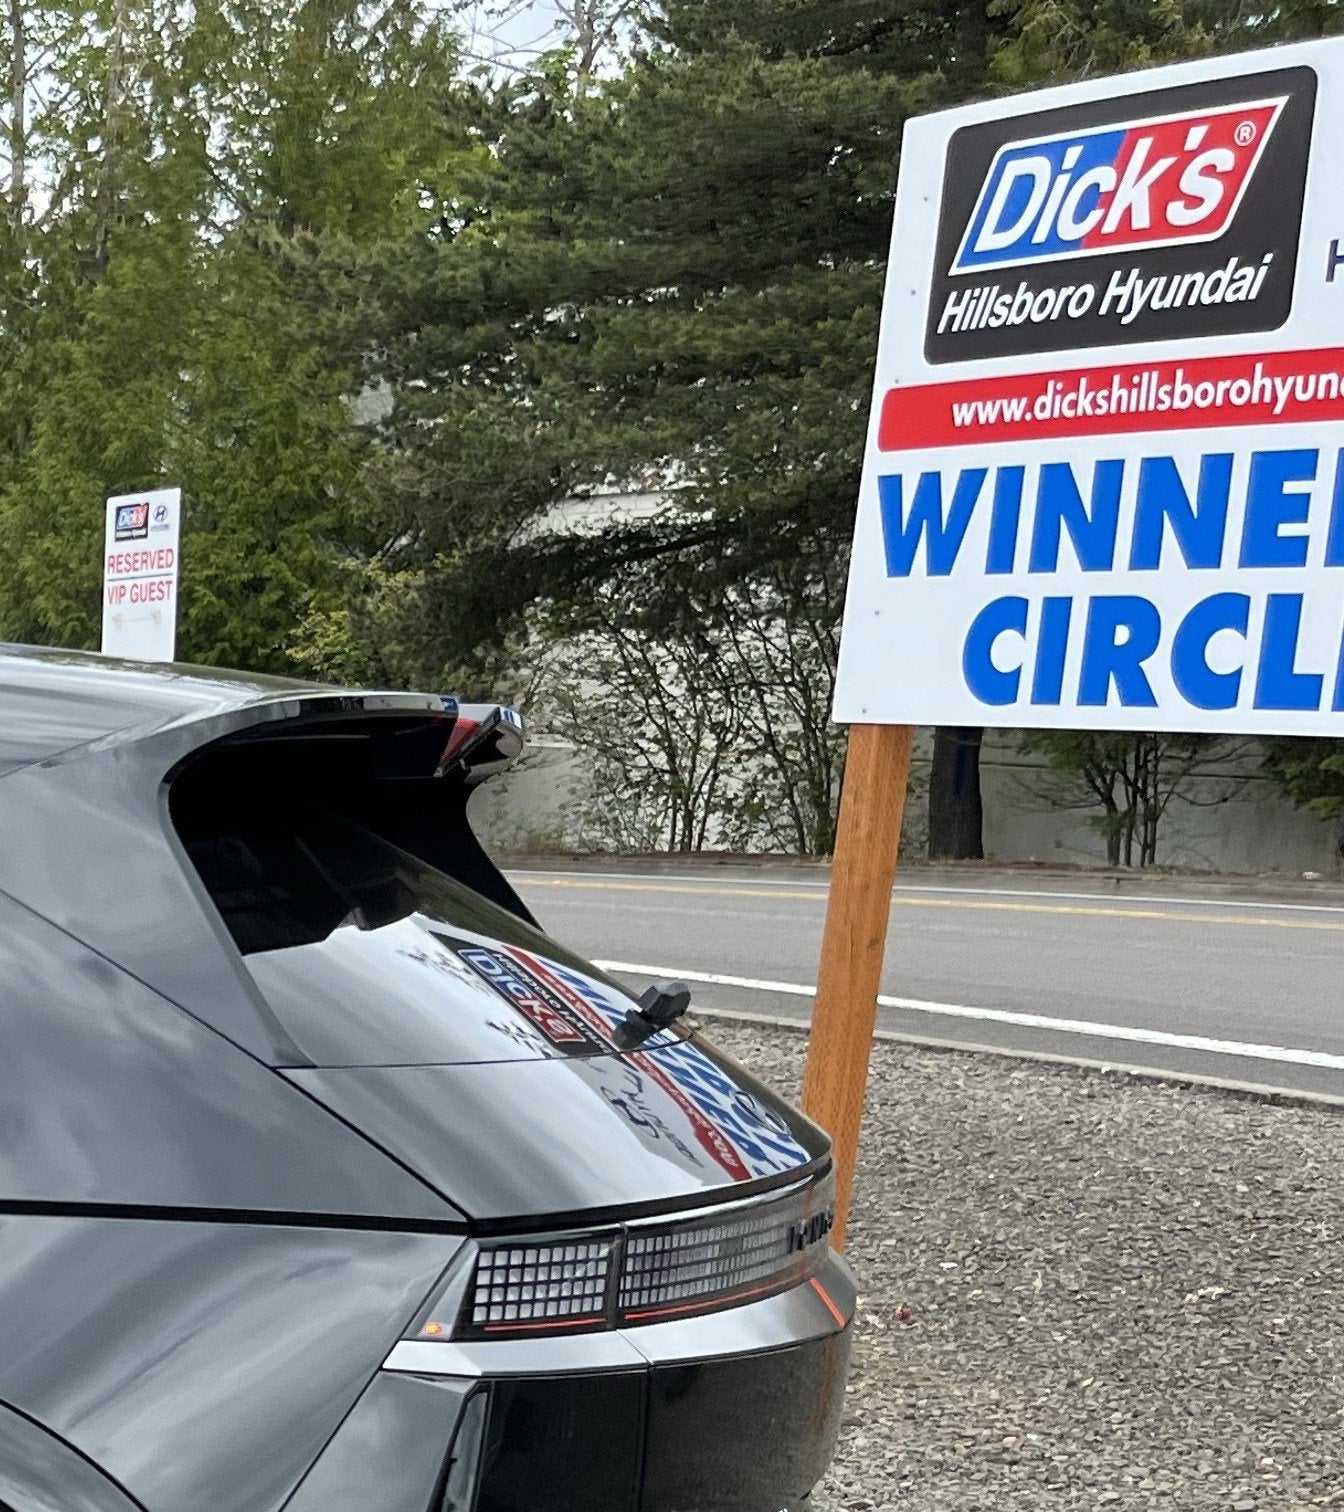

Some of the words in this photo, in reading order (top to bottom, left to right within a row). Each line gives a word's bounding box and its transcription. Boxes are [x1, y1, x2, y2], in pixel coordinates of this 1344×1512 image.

[936, 281, 1095, 335] Hillsboro
[1098, 252, 1274, 326] Hyundai
[951, 361, 1344, 428] www.dickshillsborohyun
[107, 548, 175, 575] RESERVED
[107, 585, 127, 605] VIP
[129, 581, 173, 604] GUEST
[961, 591, 1344, 713] CIRCL
